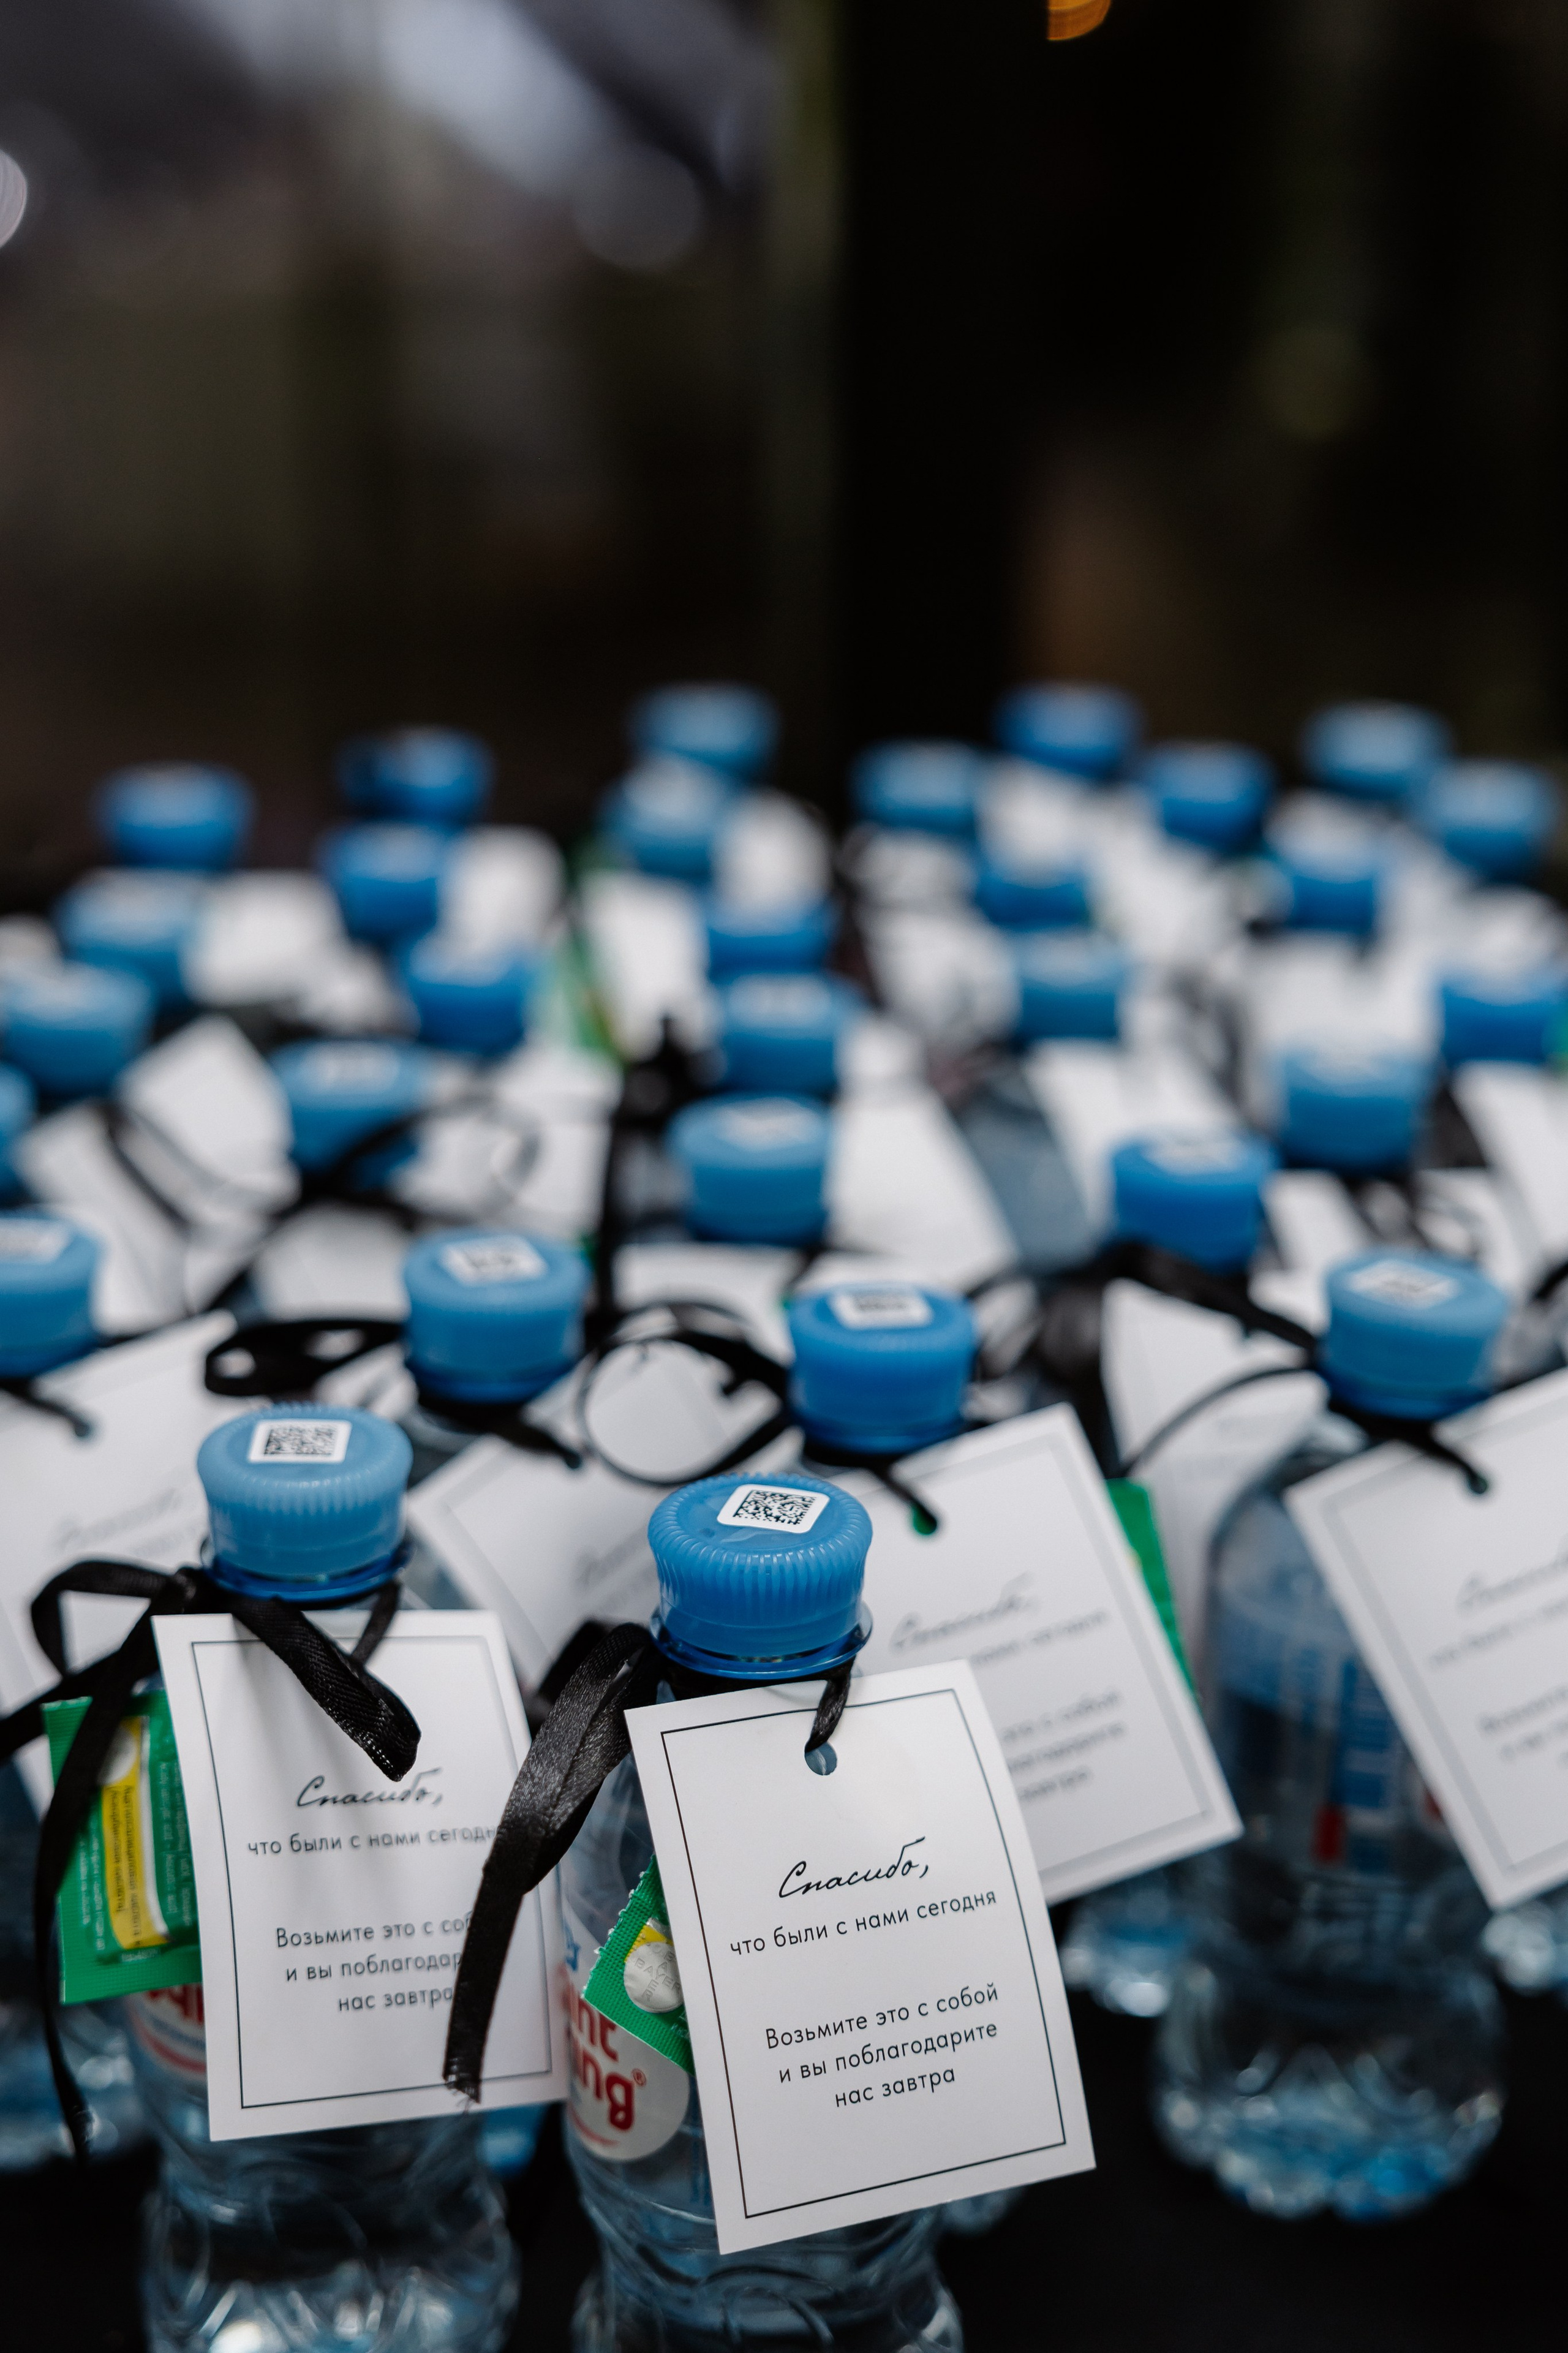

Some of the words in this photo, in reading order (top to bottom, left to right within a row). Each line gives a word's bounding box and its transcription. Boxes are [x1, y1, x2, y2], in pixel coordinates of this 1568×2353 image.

[296, 1767, 443, 1808] Спасибо,
[249, 1841, 282, 1856] что
[290, 1833, 342, 1854] были
[350, 1835, 361, 1849] с
[369, 1832, 420, 1848] нами
[428, 1825, 499, 1843] сегодн
[778, 1837, 929, 1898] Спасибо,
[276, 1927, 374, 1948] Возьмите
[383, 1924, 415, 1939] это
[424, 1921, 434, 1934] с
[730, 1938, 765, 1955] что
[774, 1926, 827, 1947] были
[836, 1922, 848, 1935] с
[856, 1908, 909, 1931] нами
[917, 1890, 997, 1918] сегодня
[286, 1967, 298, 1982] и
[307, 1965, 332, 1980] вы
[341, 1952, 461, 1977] поблагодар
[339, 1993, 375, 2012] нас
[766, 2015, 867, 2049] Возьмите
[876, 2007, 909, 2026] это
[918, 2003, 929, 2017] с
[937, 1982, 998, 2012] собой
[779, 2067, 791, 2083] и
[800, 2060, 826, 2079] вы
[835, 2023, 997, 2071] поблагодарите
[835, 2085, 873, 2107] нас
[881, 2068, 956, 2098] завтра
